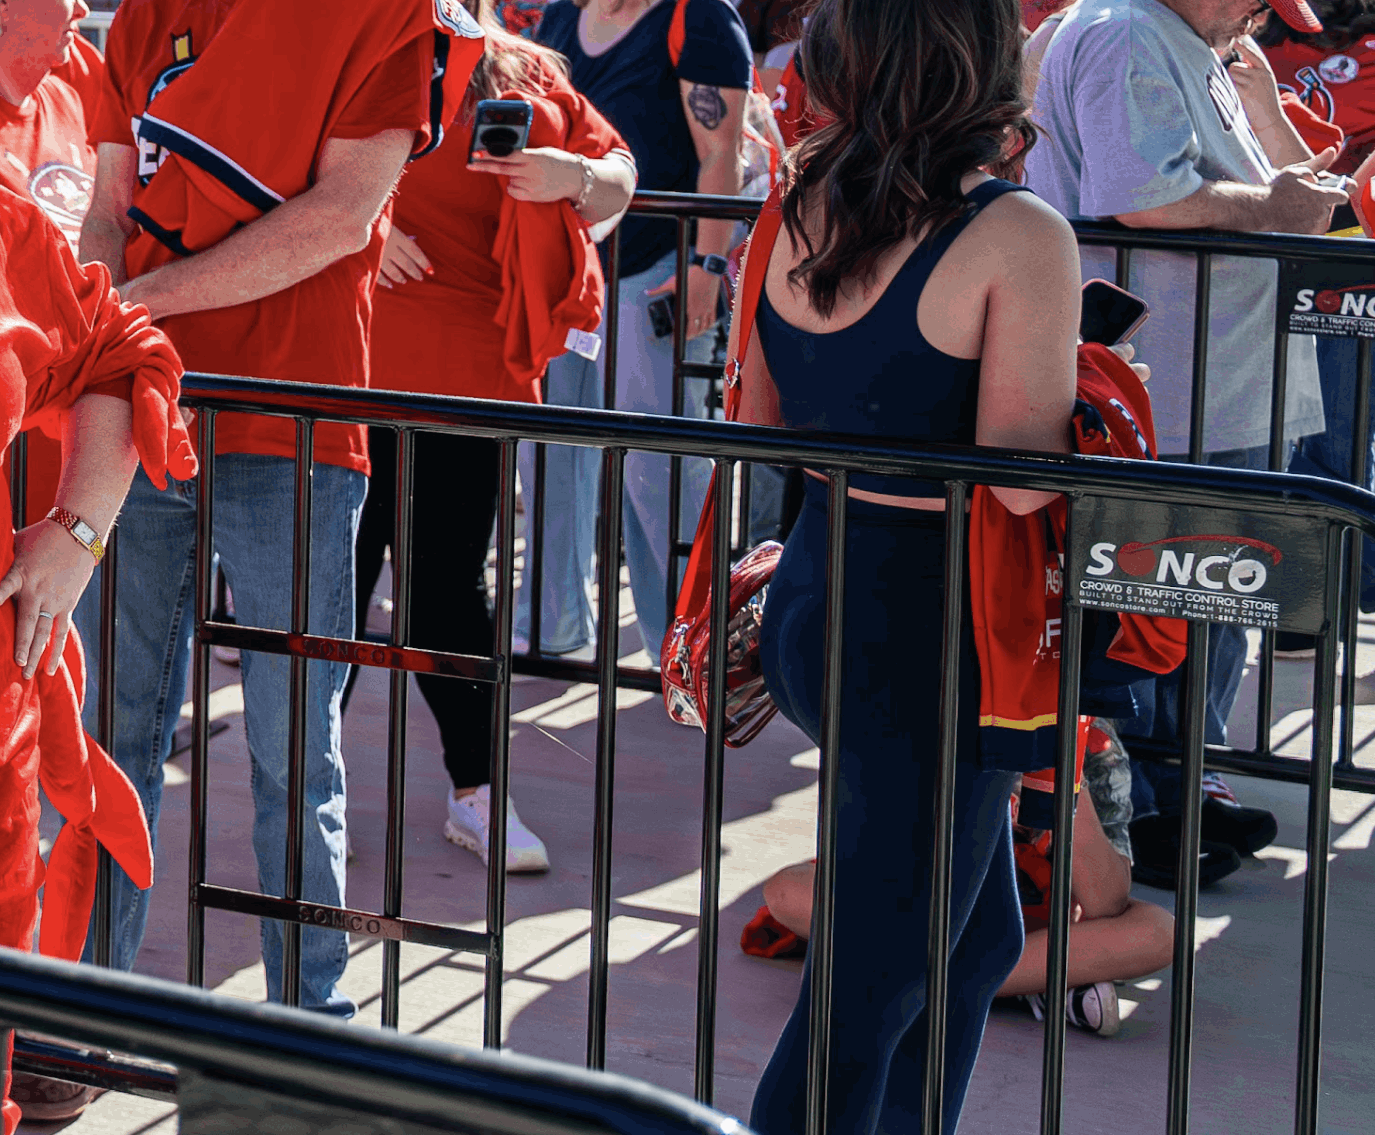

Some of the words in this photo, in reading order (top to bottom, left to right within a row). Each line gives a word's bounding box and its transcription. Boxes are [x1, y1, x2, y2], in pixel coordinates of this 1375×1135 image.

[1079, 580, 1123, 593] CROWD
[1125, 586, 1133, 595] &
[1137, 587, 1183, 601] TRAFFIC
[1184, 593, 1240, 608] CONTROL
[1241, 599, 1280, 613] STORE
[1079, 590, 1106, 599] BUILT
[1111, 593, 1123, 601] TO
[1126, 596, 1158, 605] STAND
[1187, 603, 1214, 612] FROM
[1218, 606, 1237, 615] THE
[1241, 609, 1279, 620] CROWD
[1079, 598, 1166, 613] www.soncostore.com
